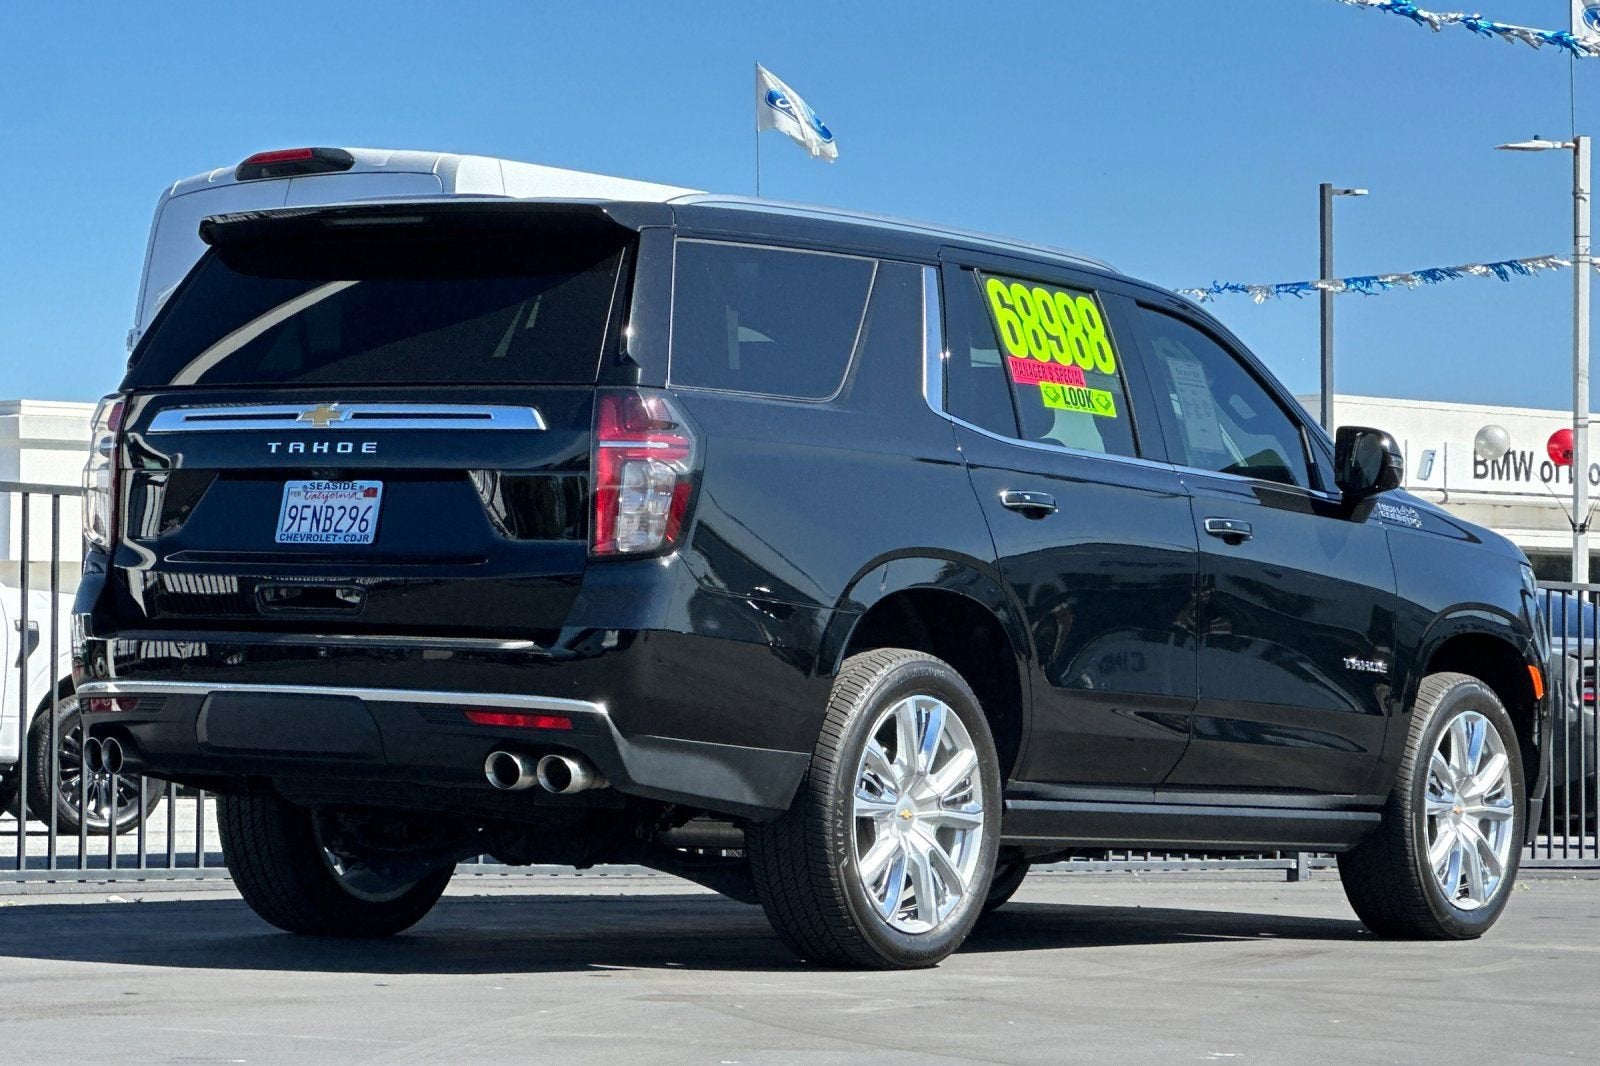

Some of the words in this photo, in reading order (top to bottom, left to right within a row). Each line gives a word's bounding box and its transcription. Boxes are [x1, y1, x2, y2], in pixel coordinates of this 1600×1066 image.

[987, 278, 1116, 374] 68988
[1012, 360, 1053, 381] MANAGER'S
[1054, 366, 1084, 386] SPECIAL
[1061, 386, 1095, 409] LOOK
[267, 442, 377, 453] TAHOE
[1474, 447, 1534, 482] BMW
[304, 488, 364, 504] California
[309, 482, 358, 491] SEASIDE
[285, 504, 373, 533] 9FNB296
[280, 533, 337, 542] CHEVROLET
[343, 534, 370, 543] CDJR
[1343, 657, 1388, 673] TAHOE
